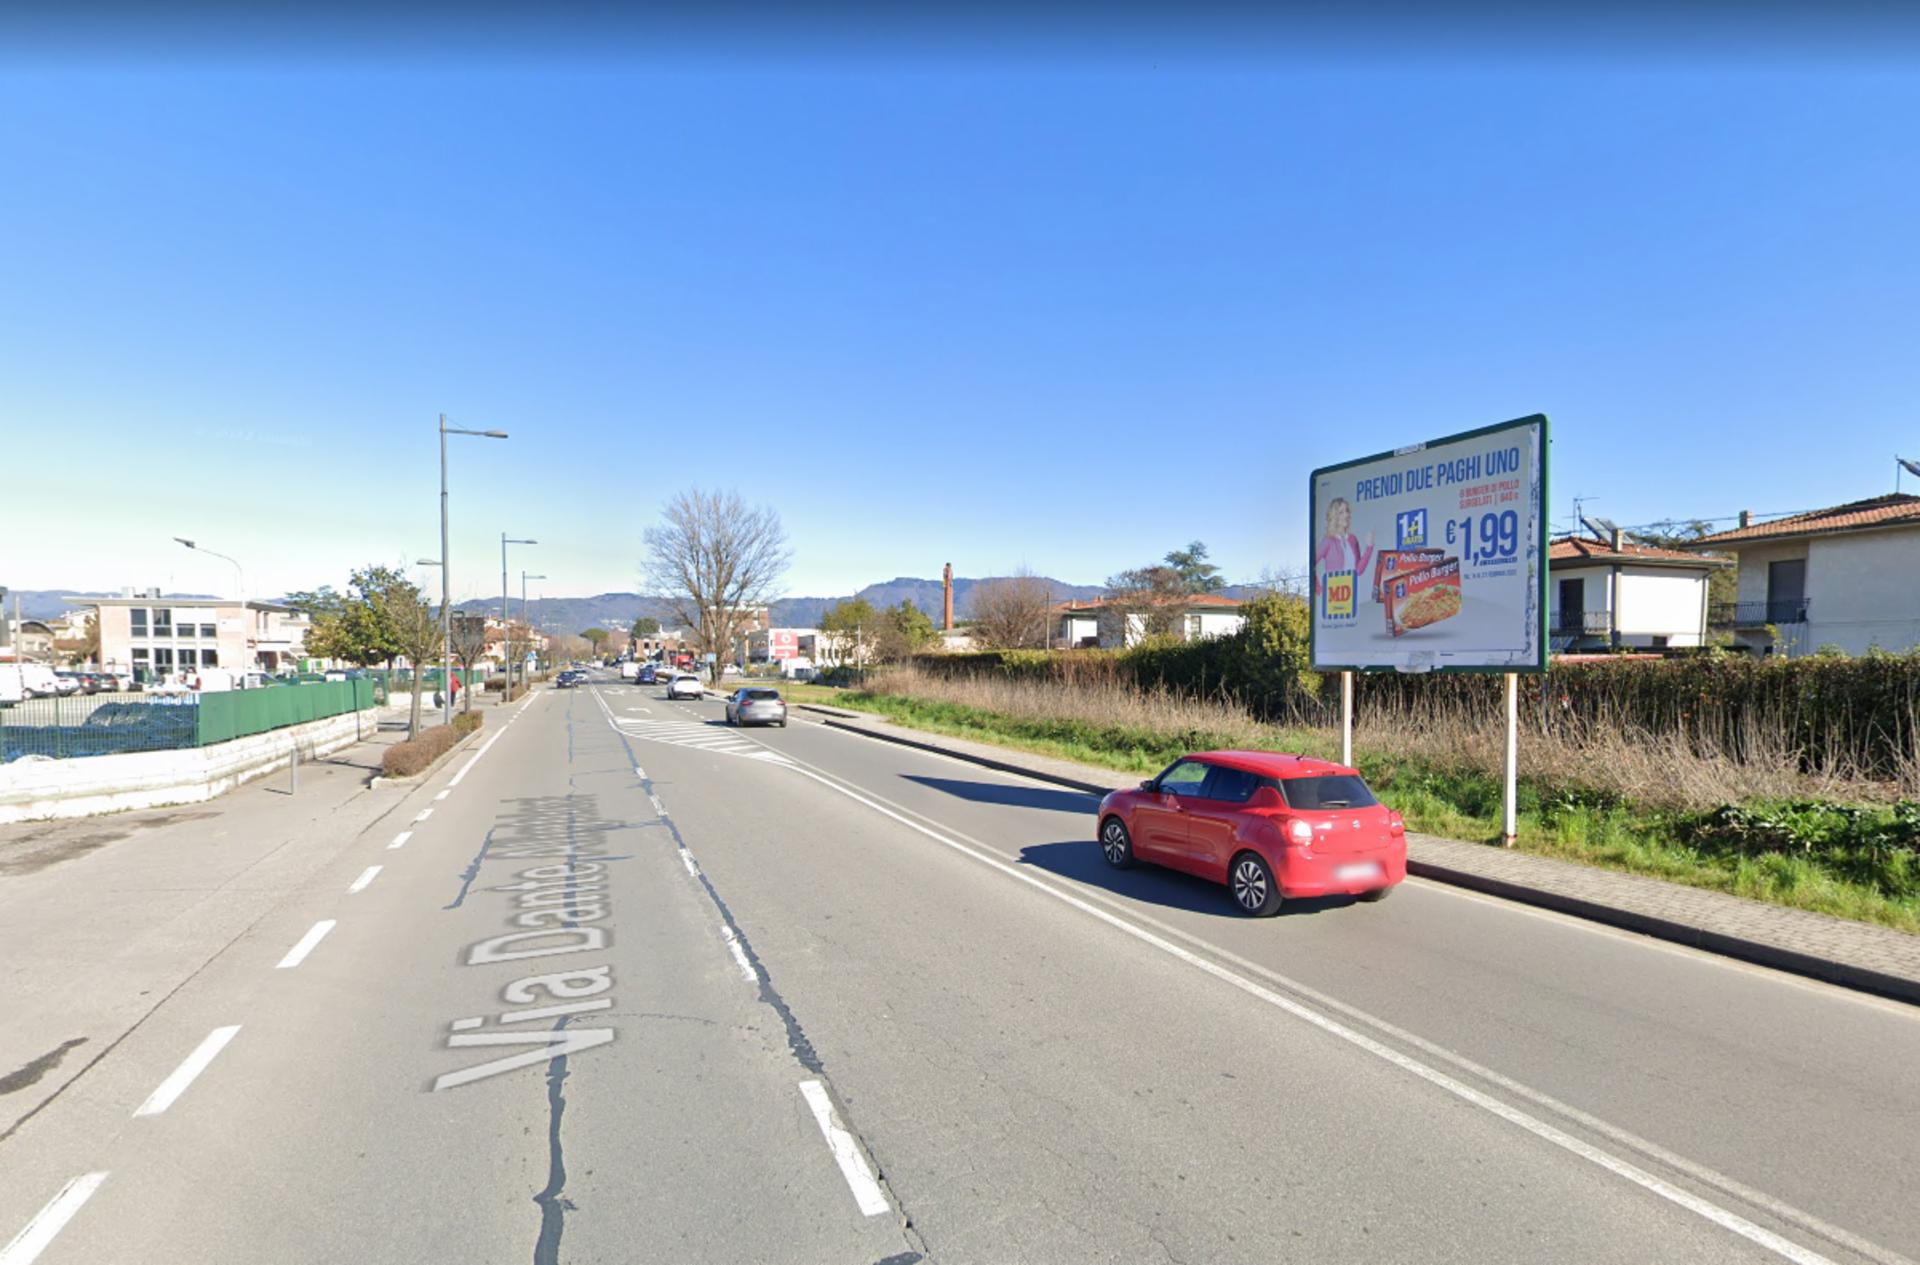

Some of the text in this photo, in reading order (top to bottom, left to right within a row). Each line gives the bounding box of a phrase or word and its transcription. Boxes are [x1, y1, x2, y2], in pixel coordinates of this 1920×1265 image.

[1357, 447, 1520, 502] PRENDI DUE PAGHI UNO
[1409, 570, 1429, 586] Pollo
[1431, 561, 1458, 579] Burger
[1328, 585, 1351, 602] MD
